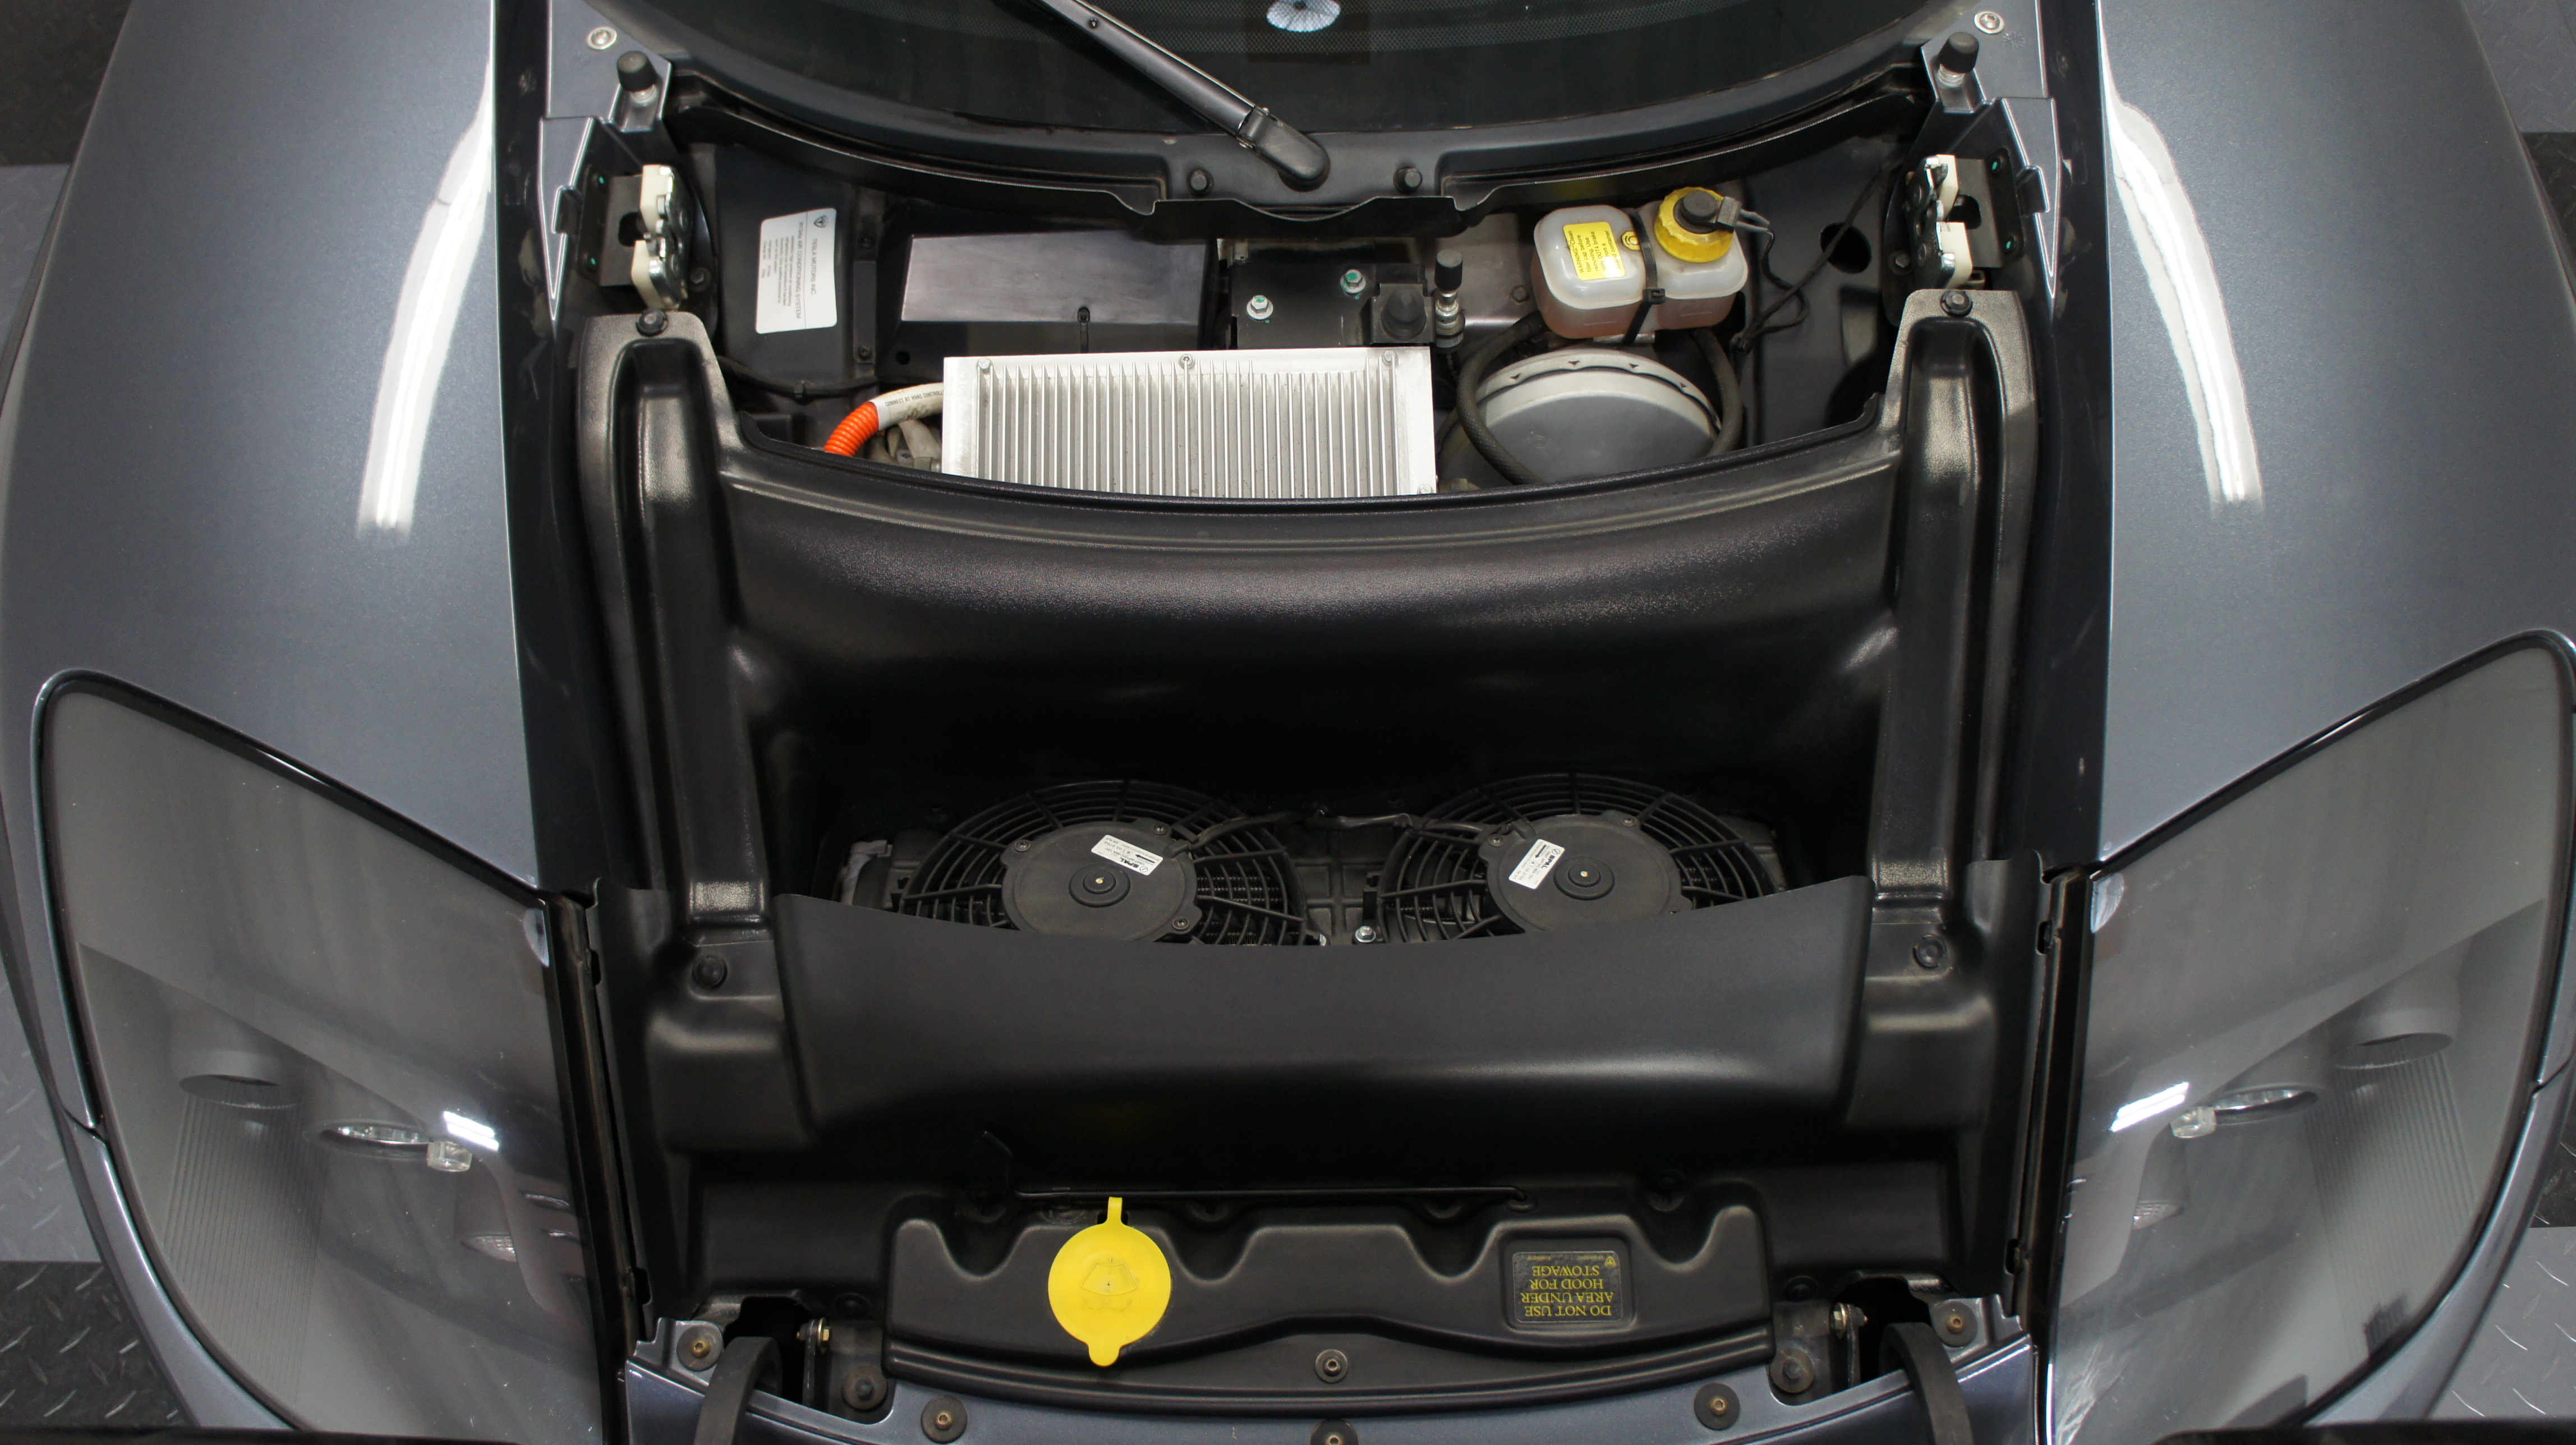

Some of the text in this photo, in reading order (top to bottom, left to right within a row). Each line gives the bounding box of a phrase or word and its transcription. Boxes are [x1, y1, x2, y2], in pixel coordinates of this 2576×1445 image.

[1575, 234, 1585, 250] before
[1589, 231, 1598, 245] brake
[1118, 857, 1139, 868] SPAL
[1531, 1265, 1600, 1276] STOWAGE
[1529, 1278, 1603, 1290] HOOD FOR
[1520, 1292, 1614, 1303] AREA UNDER
[1524, 1305, 1612, 1317] DO NOT USE
